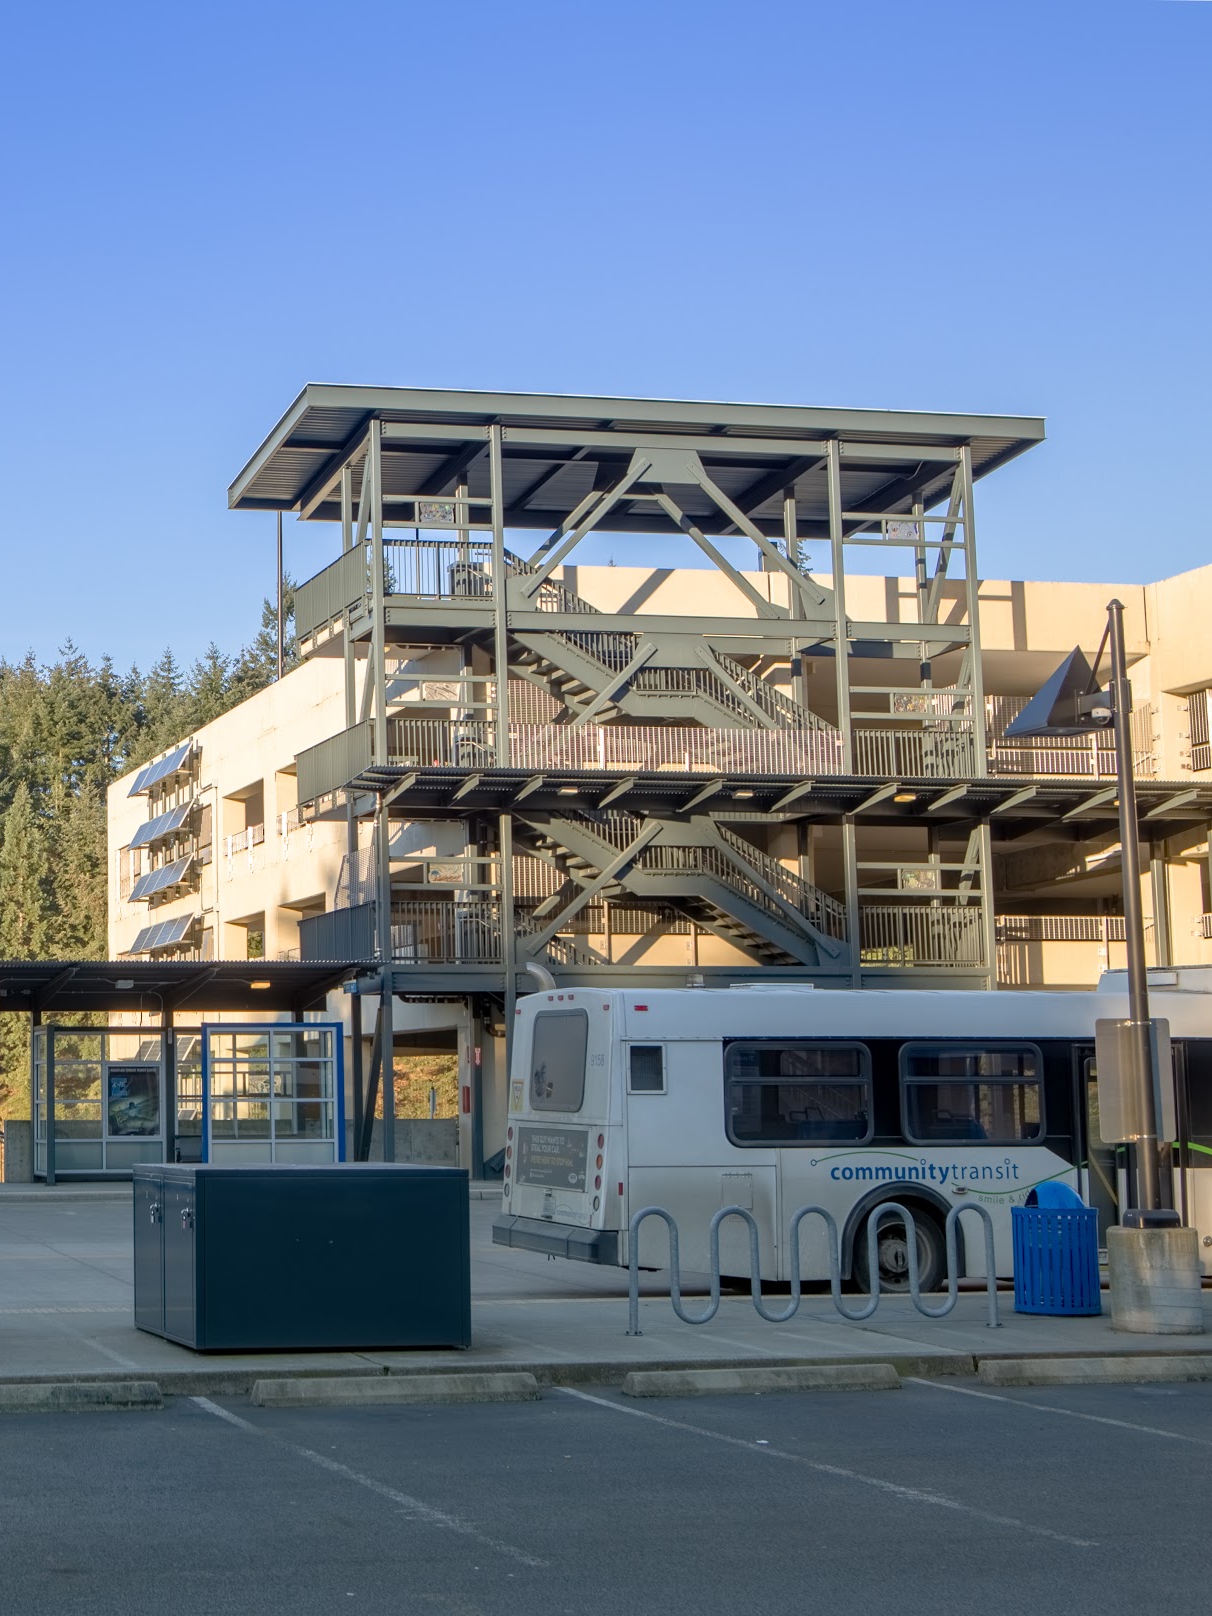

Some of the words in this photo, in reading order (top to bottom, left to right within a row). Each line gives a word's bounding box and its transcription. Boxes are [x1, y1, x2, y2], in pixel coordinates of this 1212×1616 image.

[590, 1054, 604, 1066] 9158
[978, 1195, 1004, 1204] smile
[1009, 1195, 1015, 1203] &
[1019, 1189, 1030, 1201] rid
